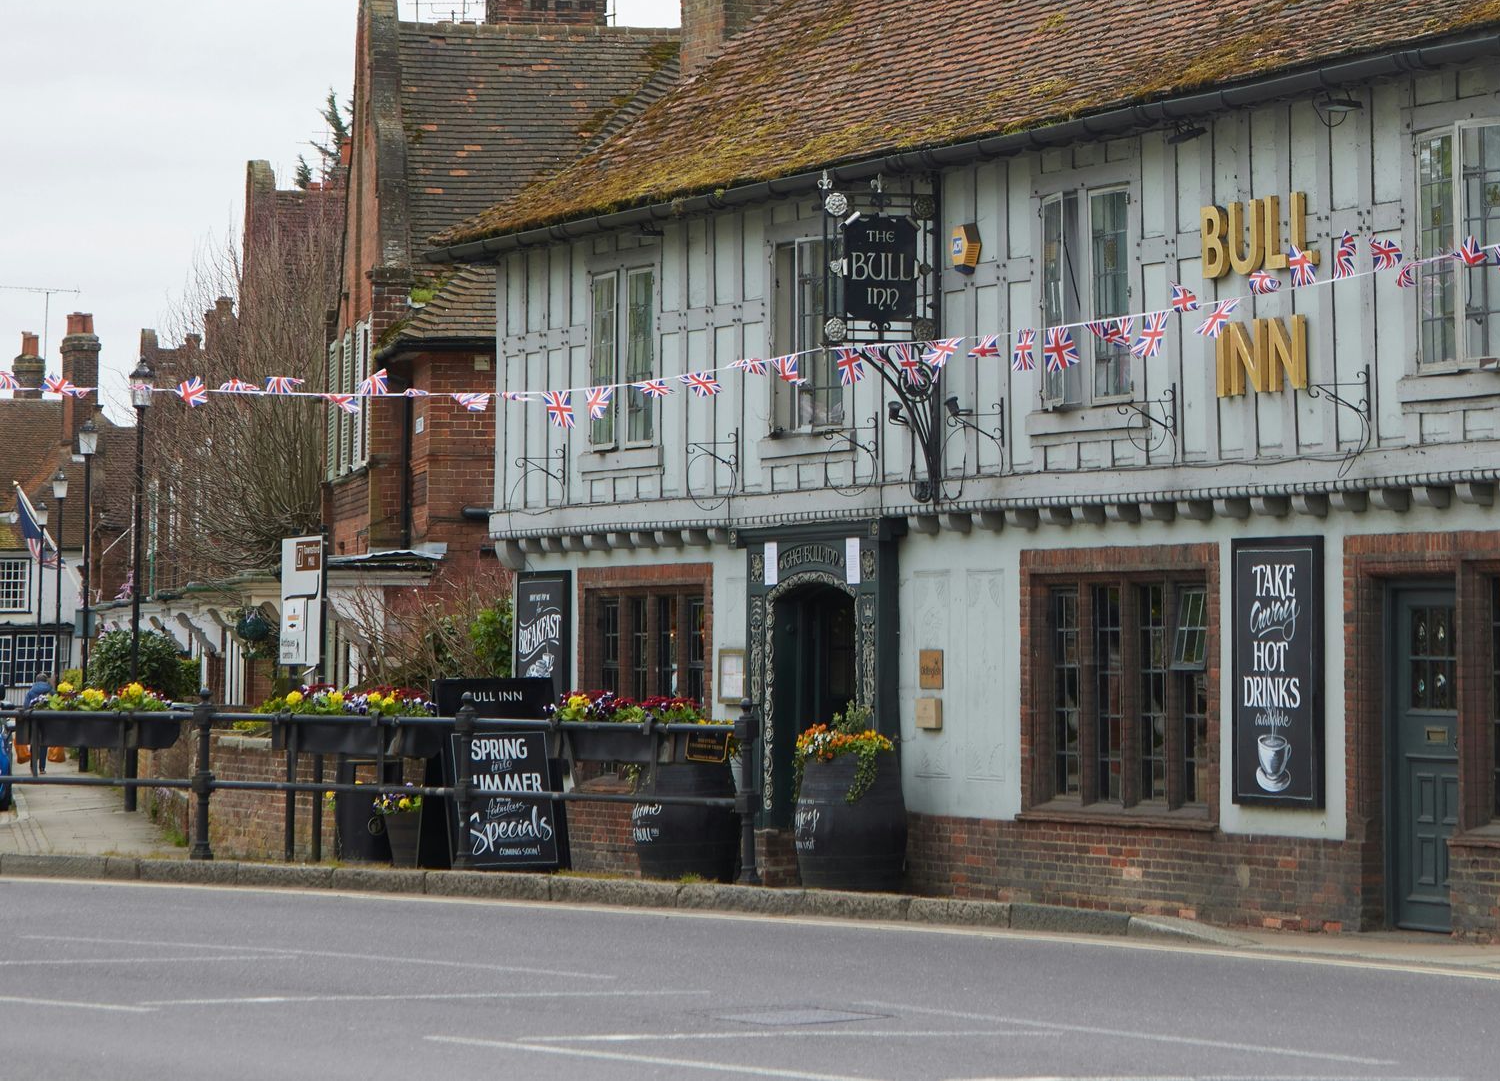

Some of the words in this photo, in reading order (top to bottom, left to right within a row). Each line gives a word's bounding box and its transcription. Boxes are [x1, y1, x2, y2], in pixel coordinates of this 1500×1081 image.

[866, 230, 895, 243] THE
[1201, 191, 1320, 280] BULL
[851, 252, 912, 281] BULL
[867, 288, 899, 311] INN
[1216, 314, 1308, 398] INN
[804, 545, 824, 562] BULL
[1252, 564, 1296, 600] TAKE
[519, 614, 562, 654] BREAKFAST
[1250, 599, 1300, 641] away
[1253, 641, 1289, 672] HOT
[473, 691, 496, 702] ULL
[499, 691, 523, 702] INN
[1244, 677, 1301, 709] DRINKS
[471, 738, 527, 761] SPRING
[473, 772, 543, 792] UMMER
[470, 805, 552, 856] Specials
[499, 846, 522, 856] COMING
